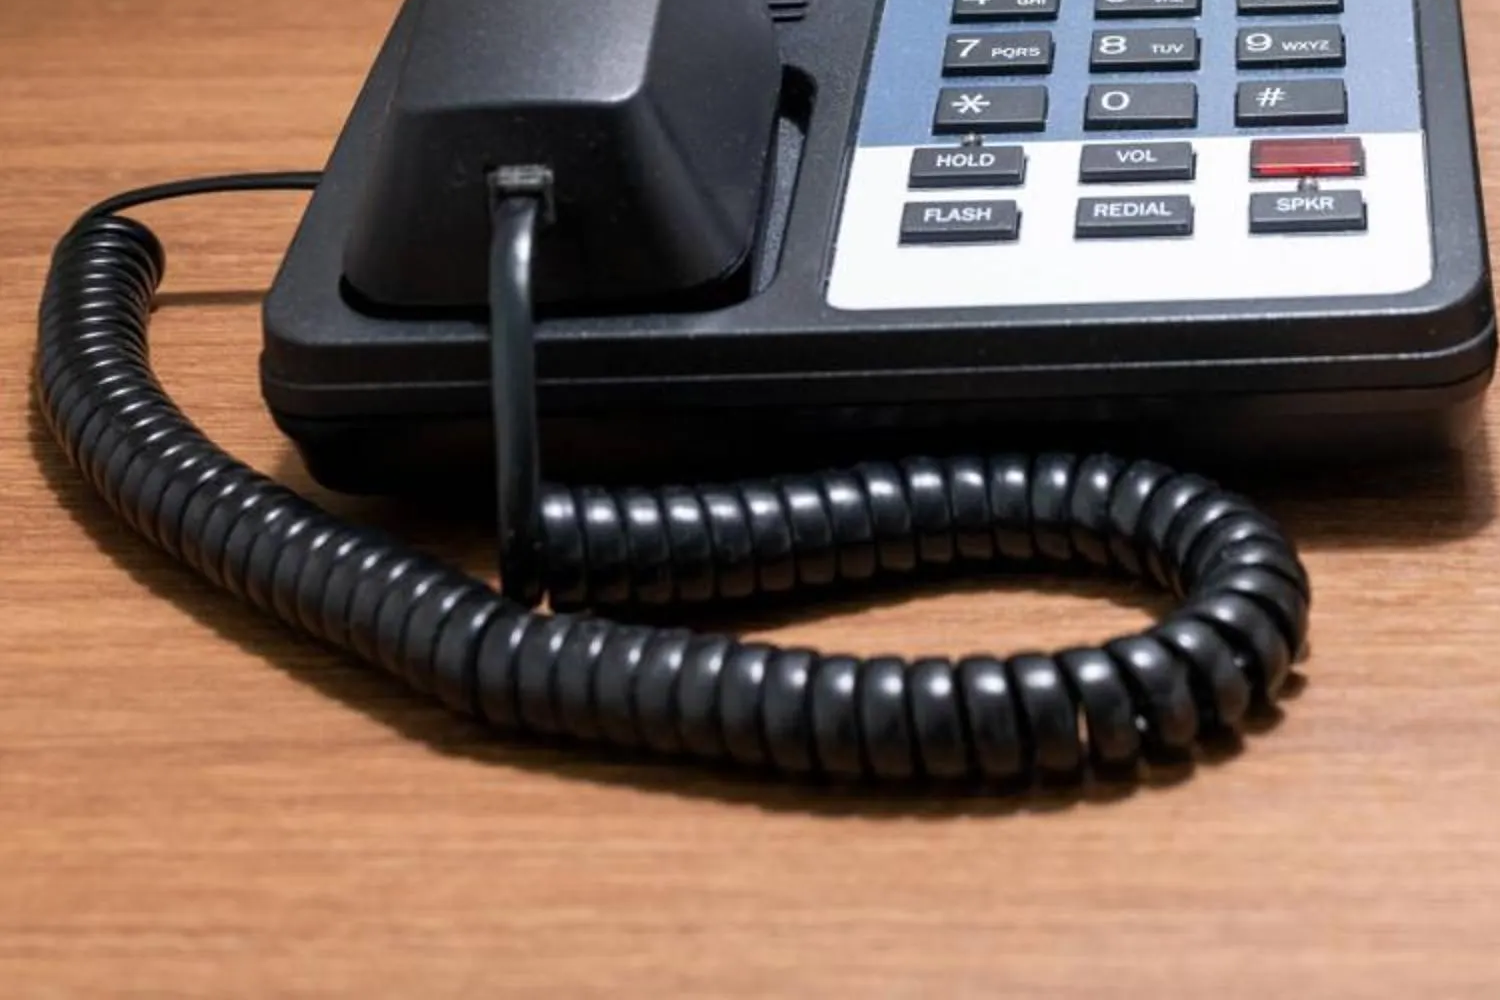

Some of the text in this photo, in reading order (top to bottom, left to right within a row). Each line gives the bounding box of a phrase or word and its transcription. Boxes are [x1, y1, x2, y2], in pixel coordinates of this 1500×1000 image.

[955, 38, 1041, 59] 7 PQRS
[1099, 35, 1185, 55] 8 TUV
[1245, 33, 1330, 53] 9 WXYZ
[935, 151, 996, 169] HOLD
[1115, 148, 1157, 165] VOL
[1093, 200, 1173, 218] REDIAL
[1275, 196, 1335, 213] SPKR
[923, 206, 992, 222] FLASH
